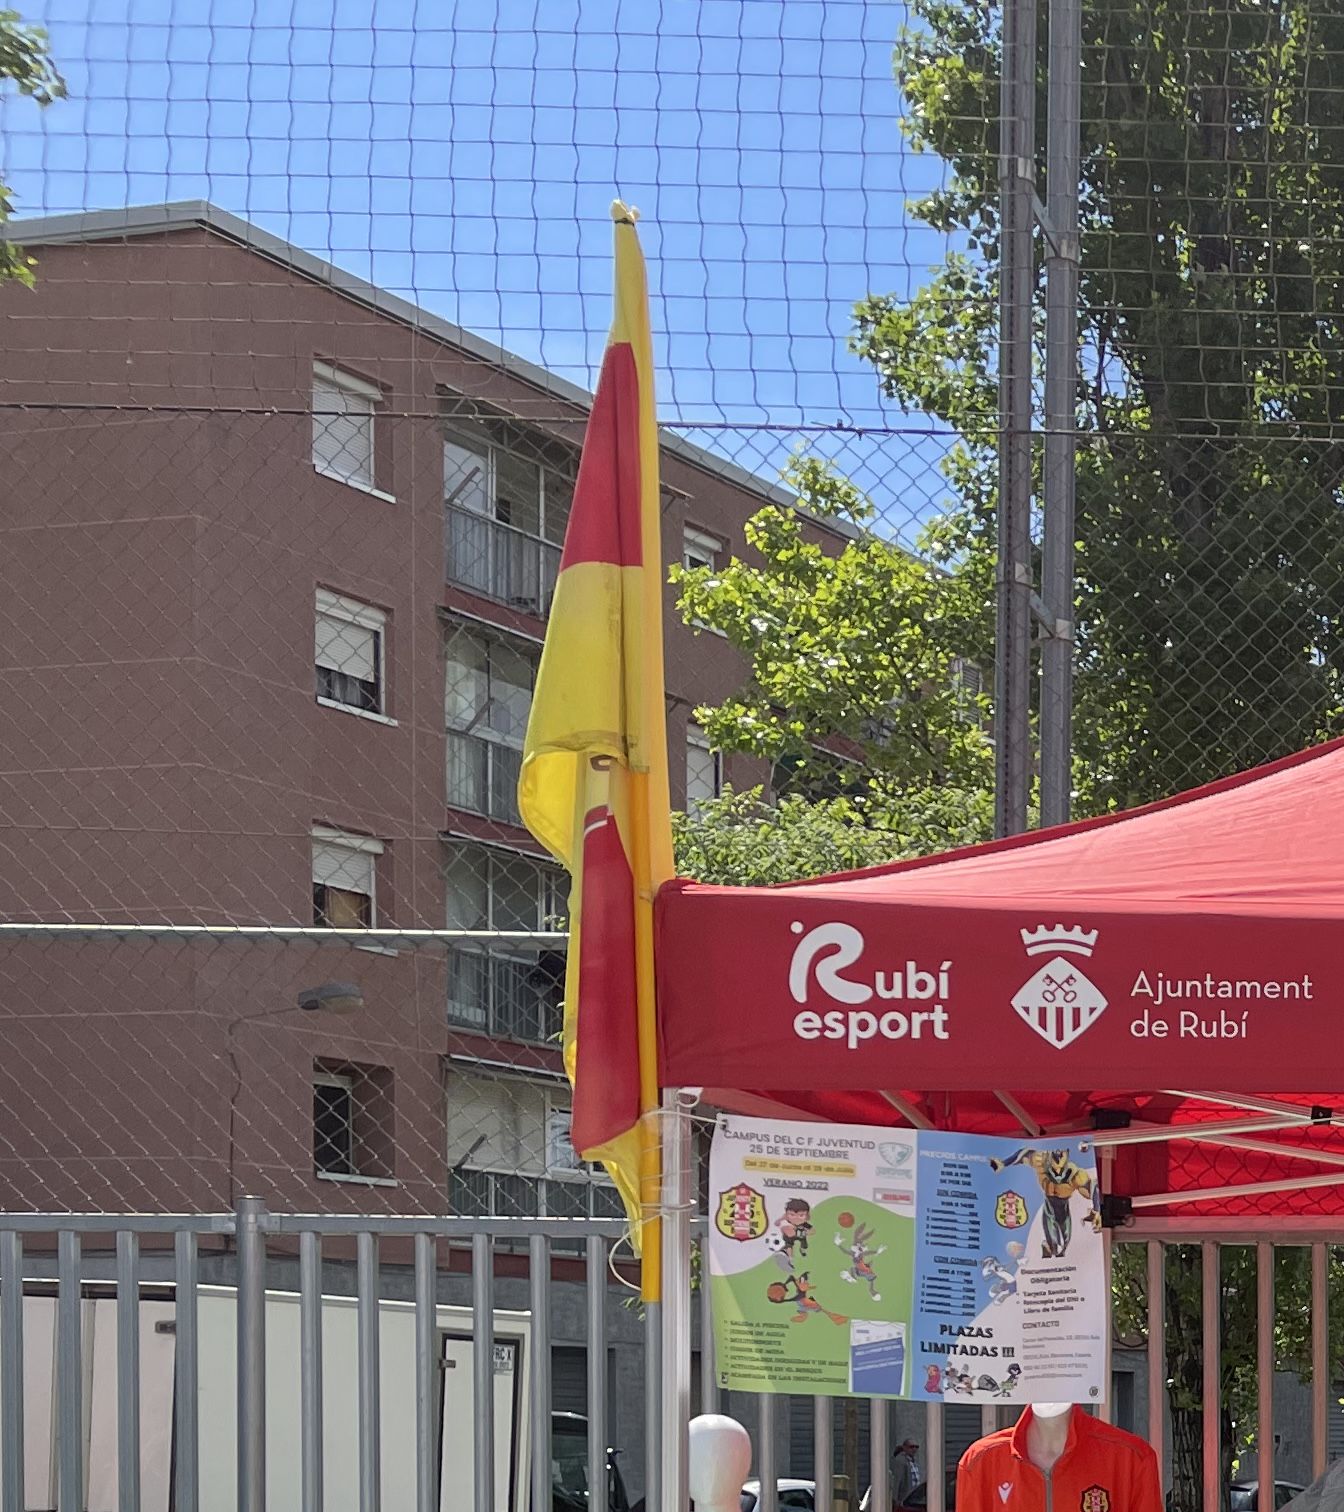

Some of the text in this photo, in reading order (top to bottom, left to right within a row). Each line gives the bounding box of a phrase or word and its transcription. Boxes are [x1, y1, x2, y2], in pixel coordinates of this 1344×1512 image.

[787, 920, 953, 1005] Rubí
[1130, 970, 1313, 1005] Ajuntament
[793, 1004, 950, 1050] esport
[1130, 1010, 1249, 1039] de Rubí
[723, 1129, 876, 1150] CAMPUS DEL C F JUVENTUD
[750, 1144, 849, 1160] 25 DE SEPTIEMBRE
[763, 1178, 828, 1190] VERANO 2022
[939, 1324, 994, 1338] PLAZAS
[920, 1341, 998, 1357] LIMITADAS
